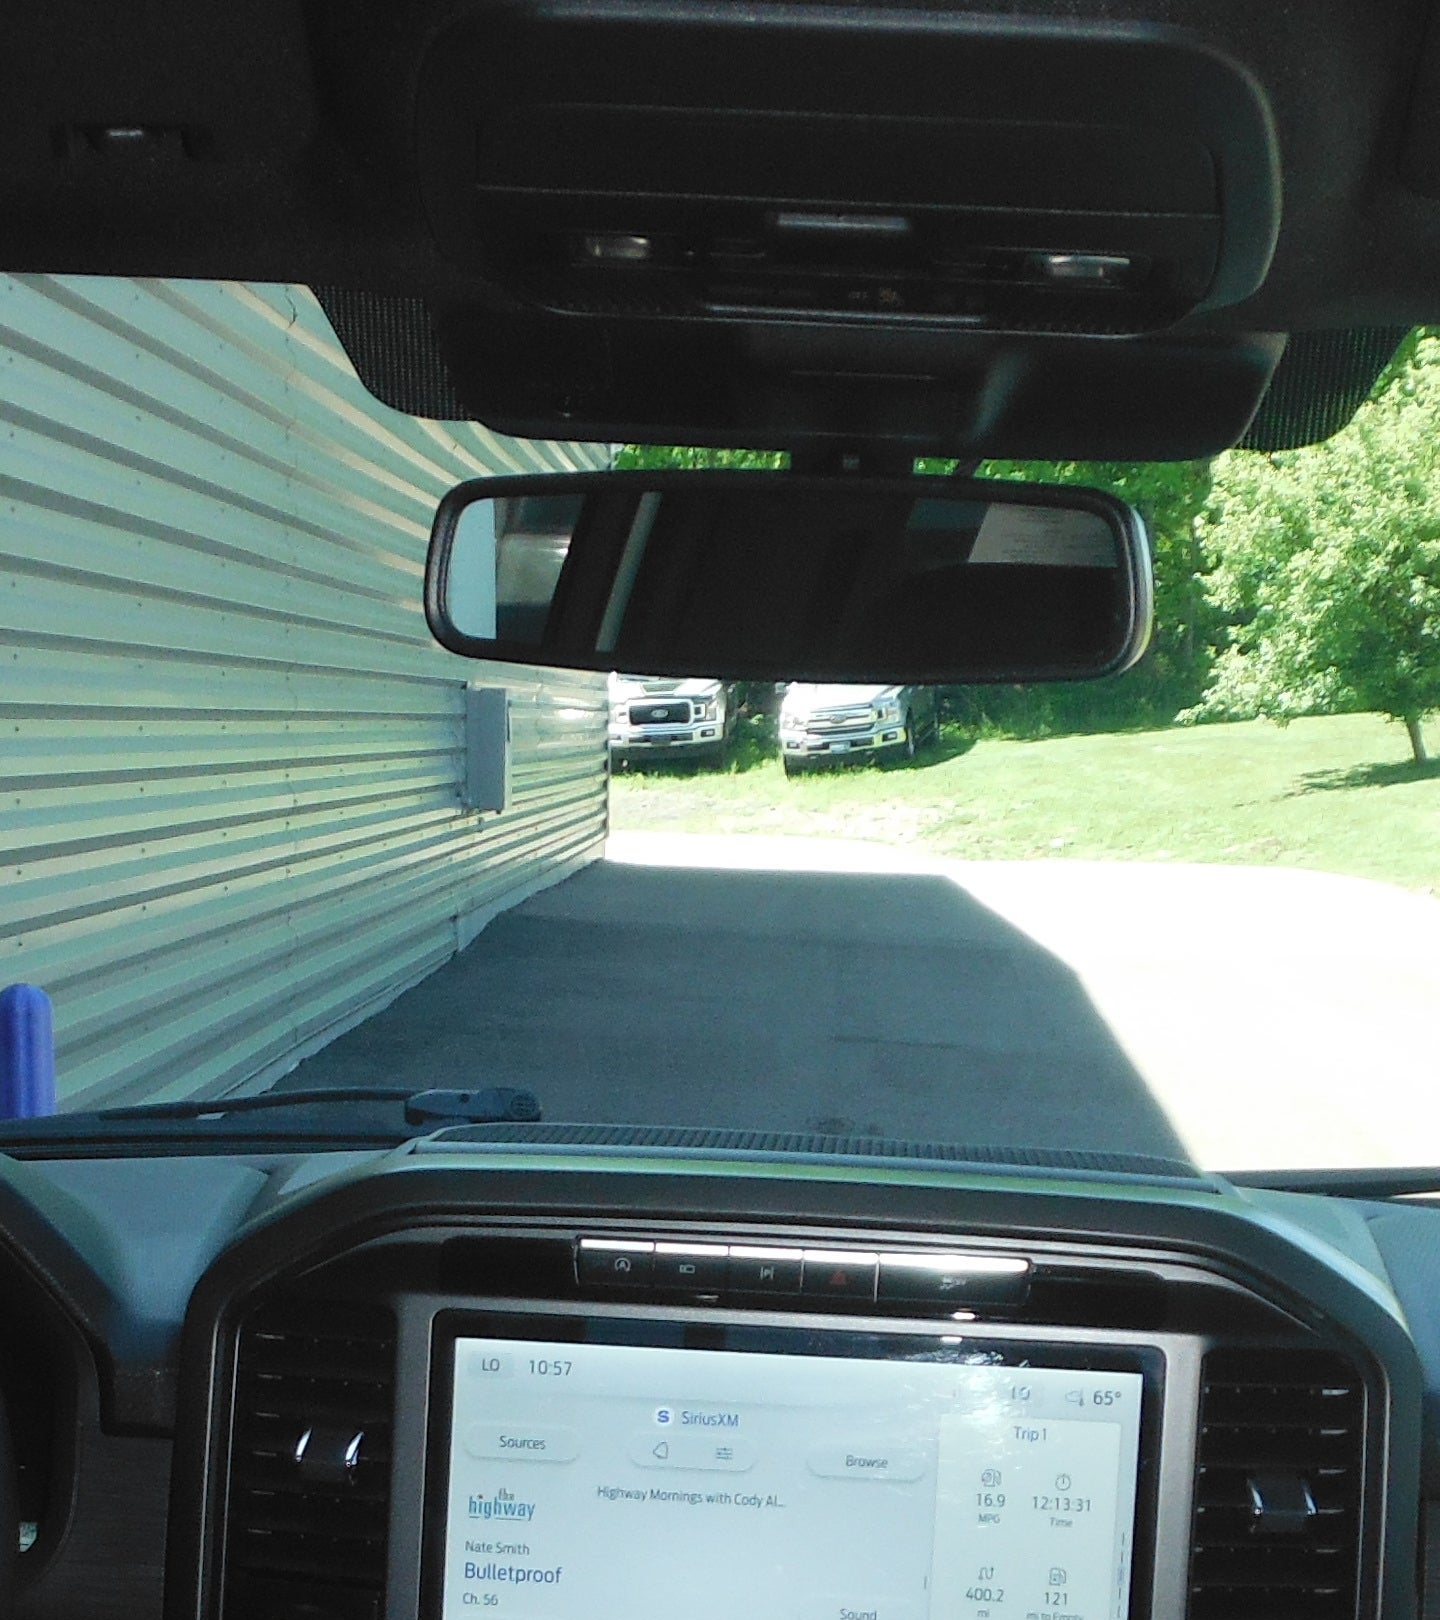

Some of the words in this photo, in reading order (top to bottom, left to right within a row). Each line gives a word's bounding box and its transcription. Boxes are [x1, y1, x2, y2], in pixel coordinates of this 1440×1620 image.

[481, 1357, 501, 1372] LO
[528, 1359, 573, 1377] 10:57
[1093, 1389, 1122, 1406] 65°
[681, 1410, 739, 1428] SiriusXM
[1014, 1425, 1039, 1442] Trip
[499, 1435, 547, 1450] Sources
[845, 1454, 889, 1469] Browse
[597, 1485, 648, 1501] Highway
[649, 1488, 703, 1505] Mornings
[705, 1492, 732, 1505] with
[733, 1493, 763, 1509] Cody
[976, 1493, 1006, 1508] 16.9
[1032, 1496, 1091, 1513] 12:13:31
[468, 1495, 536, 1522] highway
[978, 1513, 1001, 1524] MPG
[1050, 1516, 1074, 1528] Time
[465, 1539, 493, 1554] Nate
[495, 1541, 530, 1555] Smith
[464, 1561, 563, 1585] Bulletproof
[462, 1592, 480, 1605] Ch.
[483, 1594, 499, 1606] 56
[966, 1586, 1004, 1603] 400.2
[1044, 1591, 1068, 1606] 121
